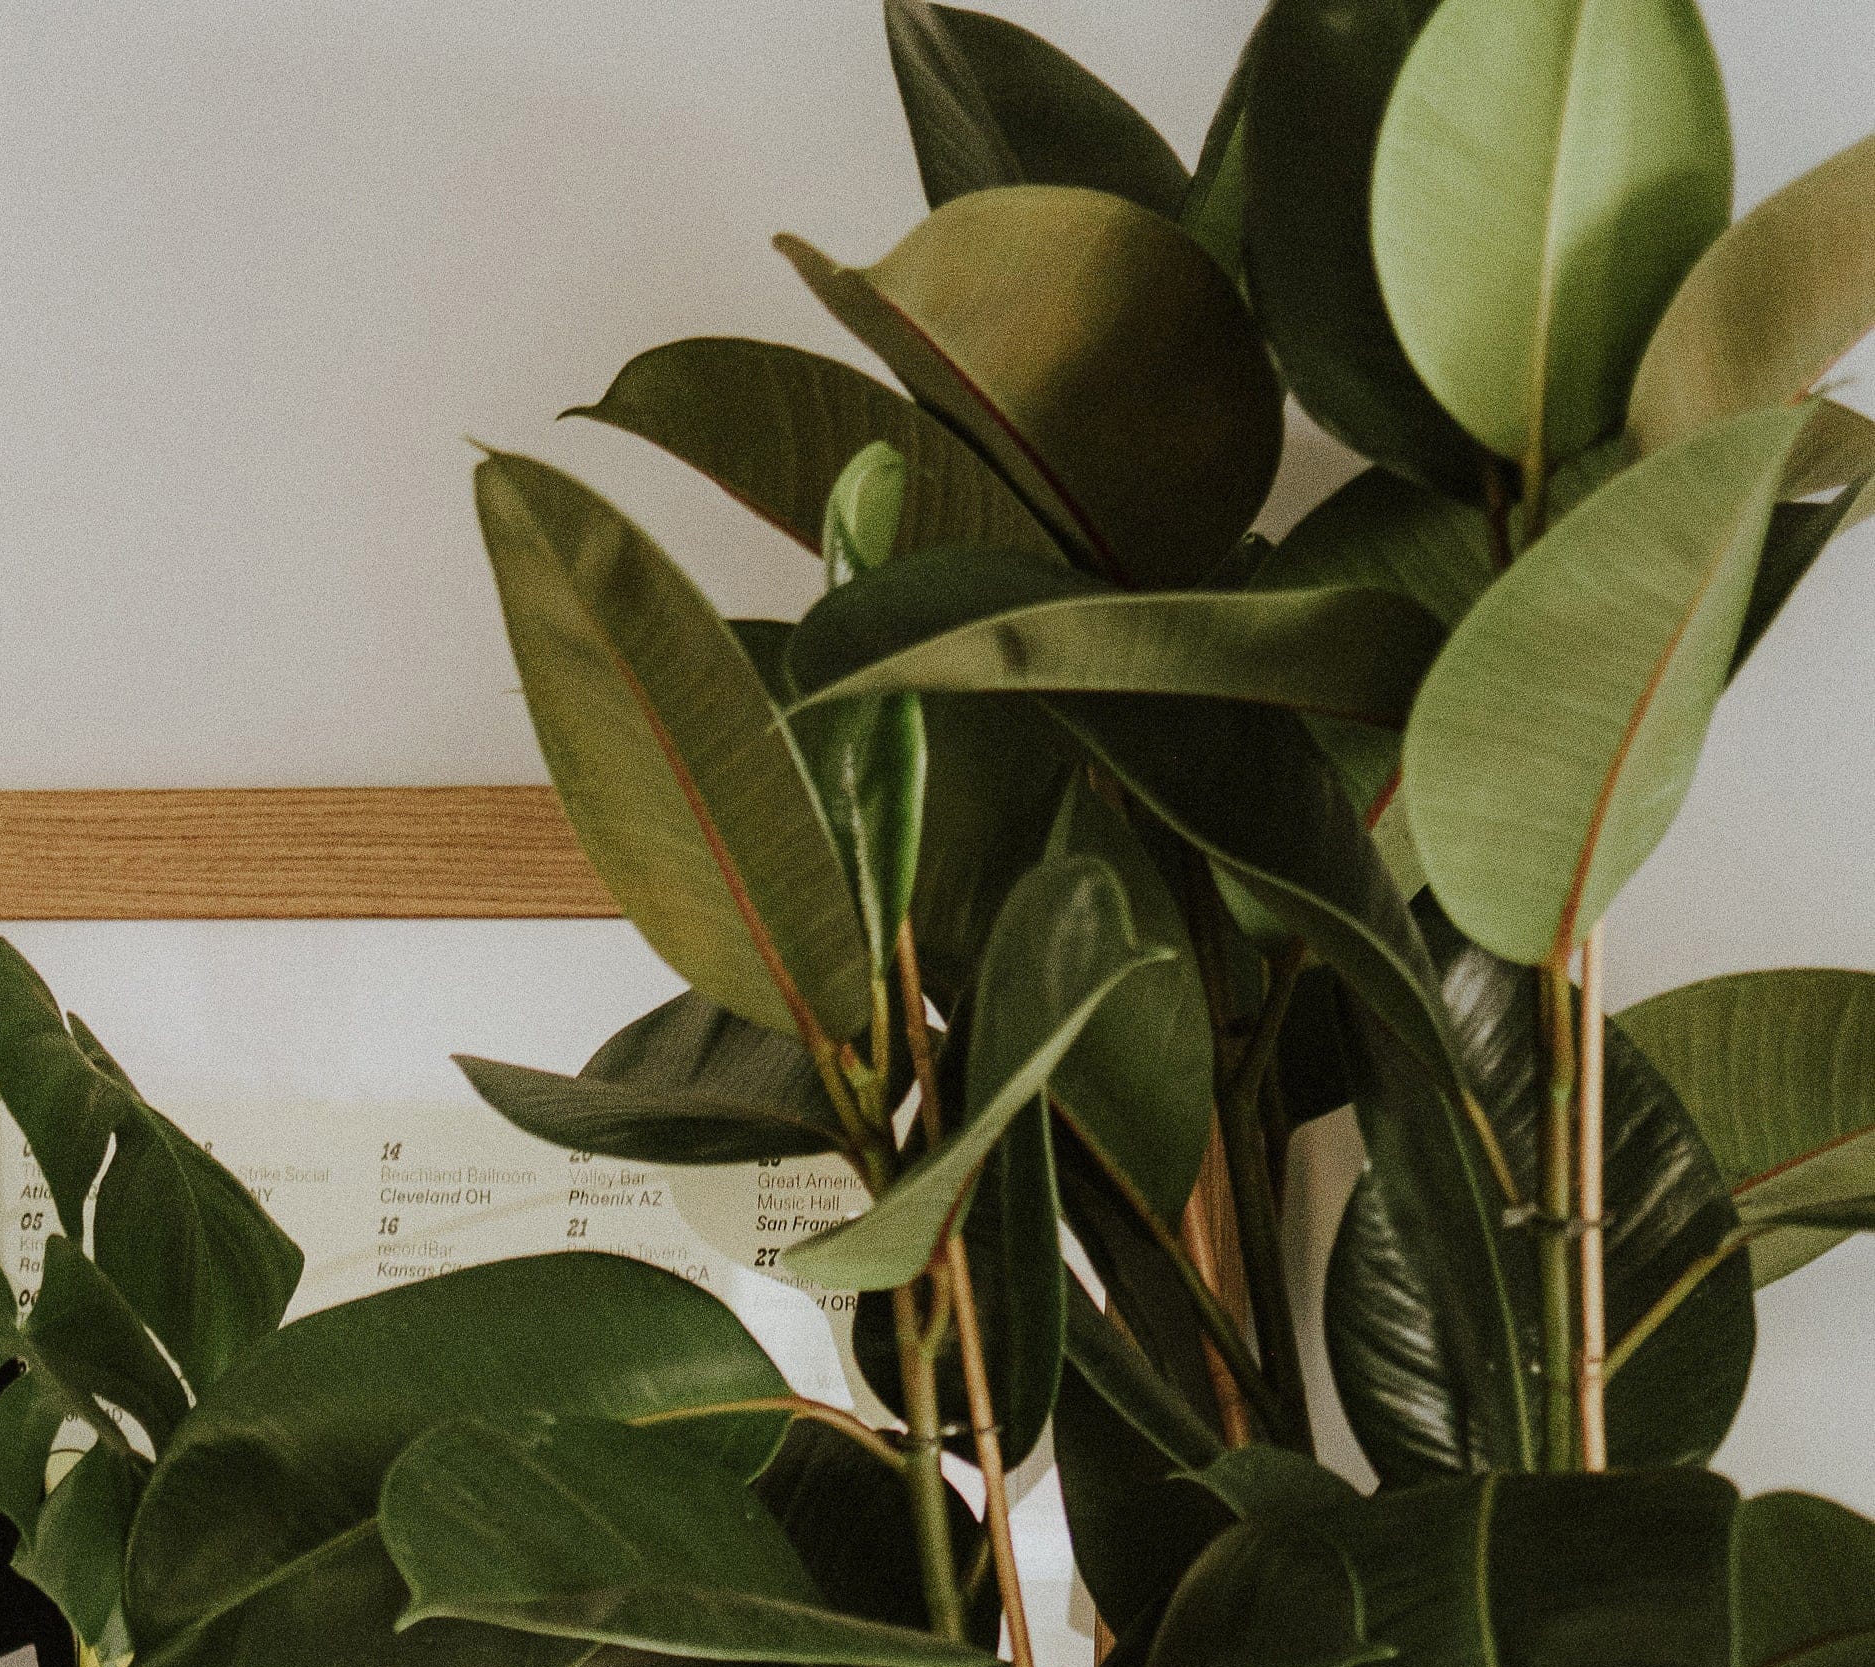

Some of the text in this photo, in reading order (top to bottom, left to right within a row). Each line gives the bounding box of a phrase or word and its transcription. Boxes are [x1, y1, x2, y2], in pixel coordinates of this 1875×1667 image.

[380, 1141, 403, 1161] 14
[380, 1165, 538, 1185] Beachland Ballroom
[570, 1168, 647, 1188] Valley Bar
[757, 1172, 864, 1191] Great Americ
[380, 1187, 492, 1205] Cleveland OH
[568, 1189, 663, 1208] Phoenix AZ
[756, 1193, 840, 1212] Music Hall
[20, 1212, 43, 1231] 05
[378, 1216, 400, 1236] 16
[566, 1218, 588, 1238] 21
[756, 1214, 844, 1233] San Franc
[377, 1240, 453, 1258] recordBar
[753, 1248, 781, 1267] 27
[377, 1262, 434, 1279] Kansas
[685, 1264, 710, 1283] CA
